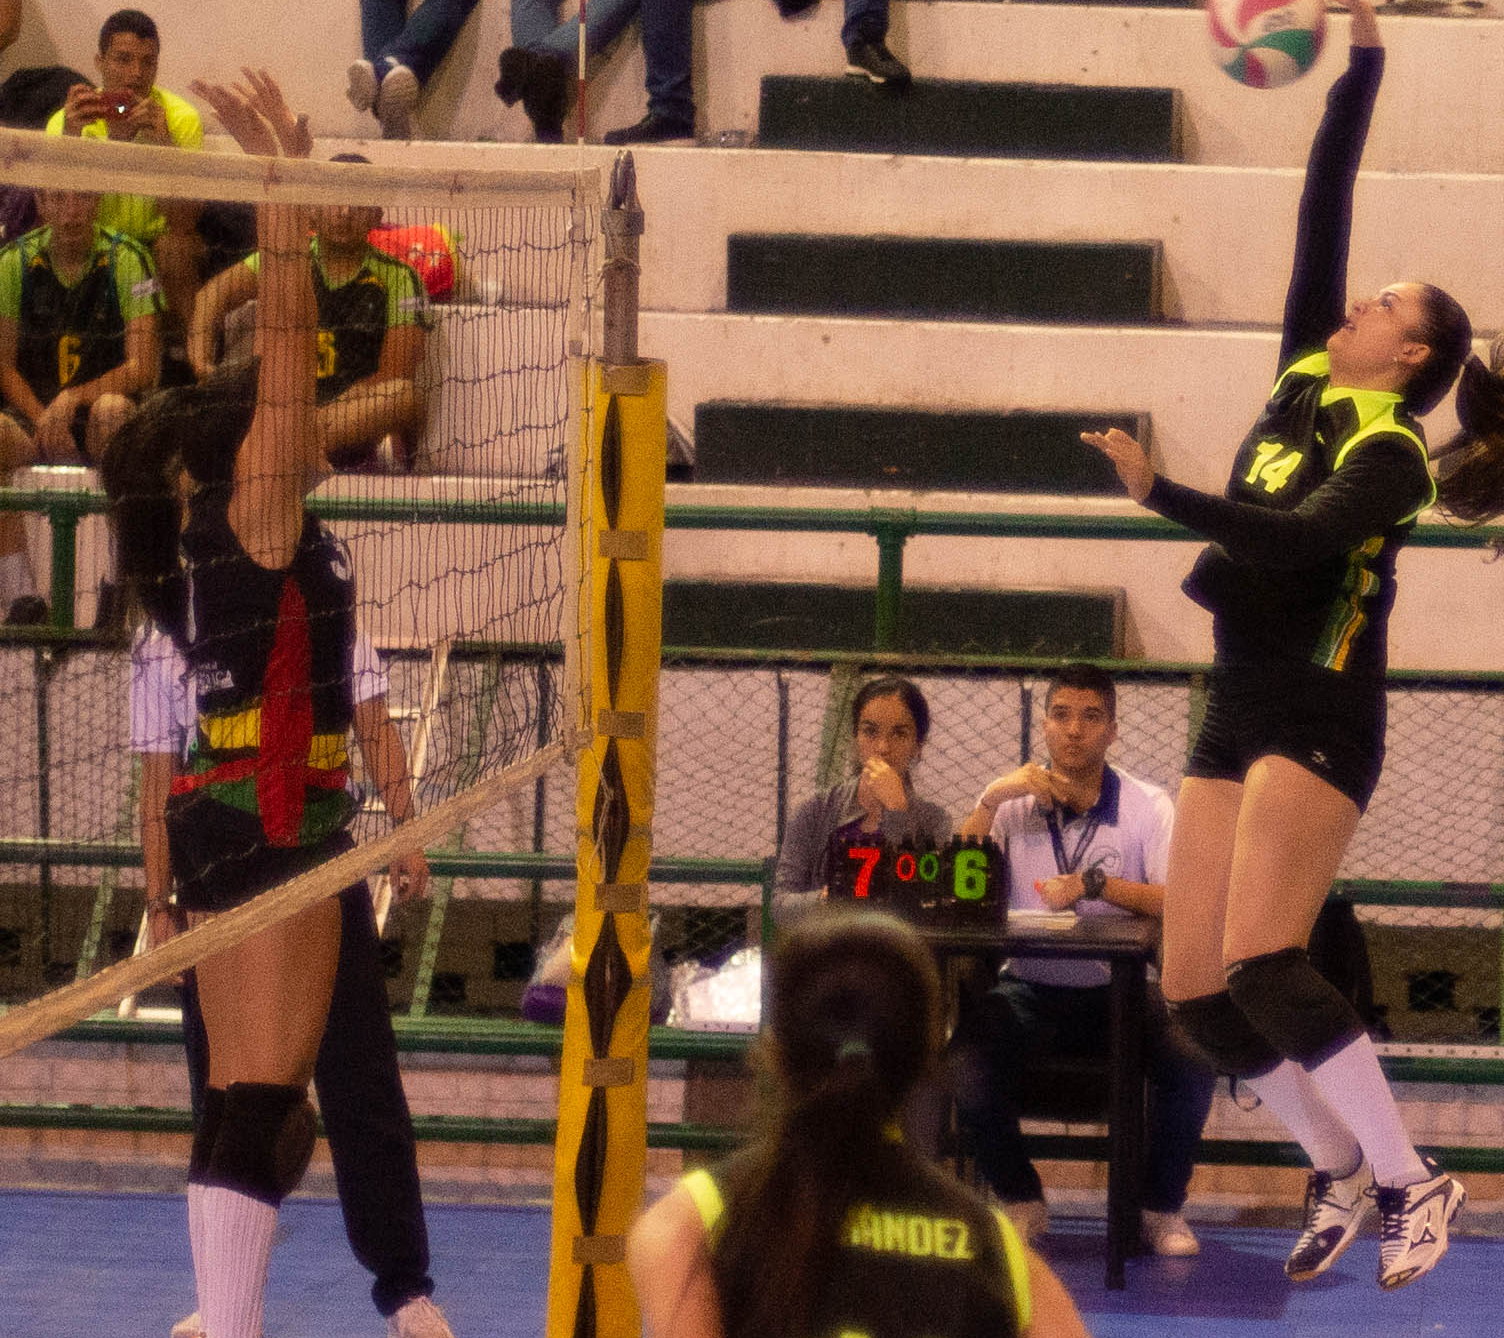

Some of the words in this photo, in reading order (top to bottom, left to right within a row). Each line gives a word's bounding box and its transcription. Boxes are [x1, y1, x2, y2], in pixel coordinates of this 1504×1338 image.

[1244, 440, 1303, 494] 14
[848, 847, 881, 898] 7
[954, 849, 988, 900] 6
